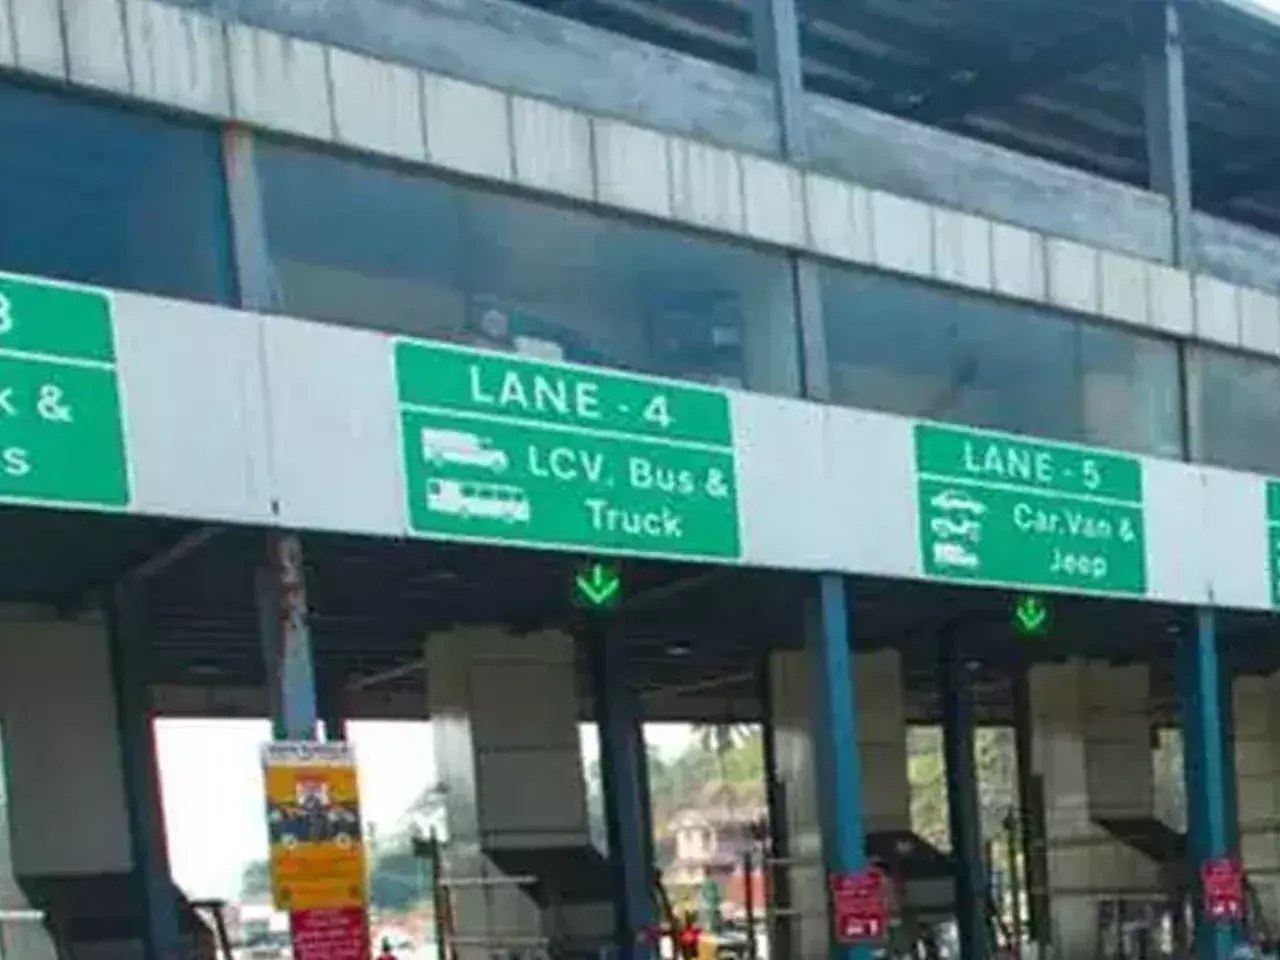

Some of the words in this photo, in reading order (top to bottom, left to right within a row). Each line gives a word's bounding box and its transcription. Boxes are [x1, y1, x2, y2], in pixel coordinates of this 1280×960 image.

[36, 383, 73, 423] &
[470, 365, 603, 421] LANE
[643, 394, 677, 429] 4
[628, 456, 696, 496] Bus
[704, 467, 730, 499] &
[962, 441, 1053, 483] LANE
[1083, 458, 1101, 490] 5
[584, 498, 684, 540] Truck
[1049, 547, 1109, 580] Jeep
